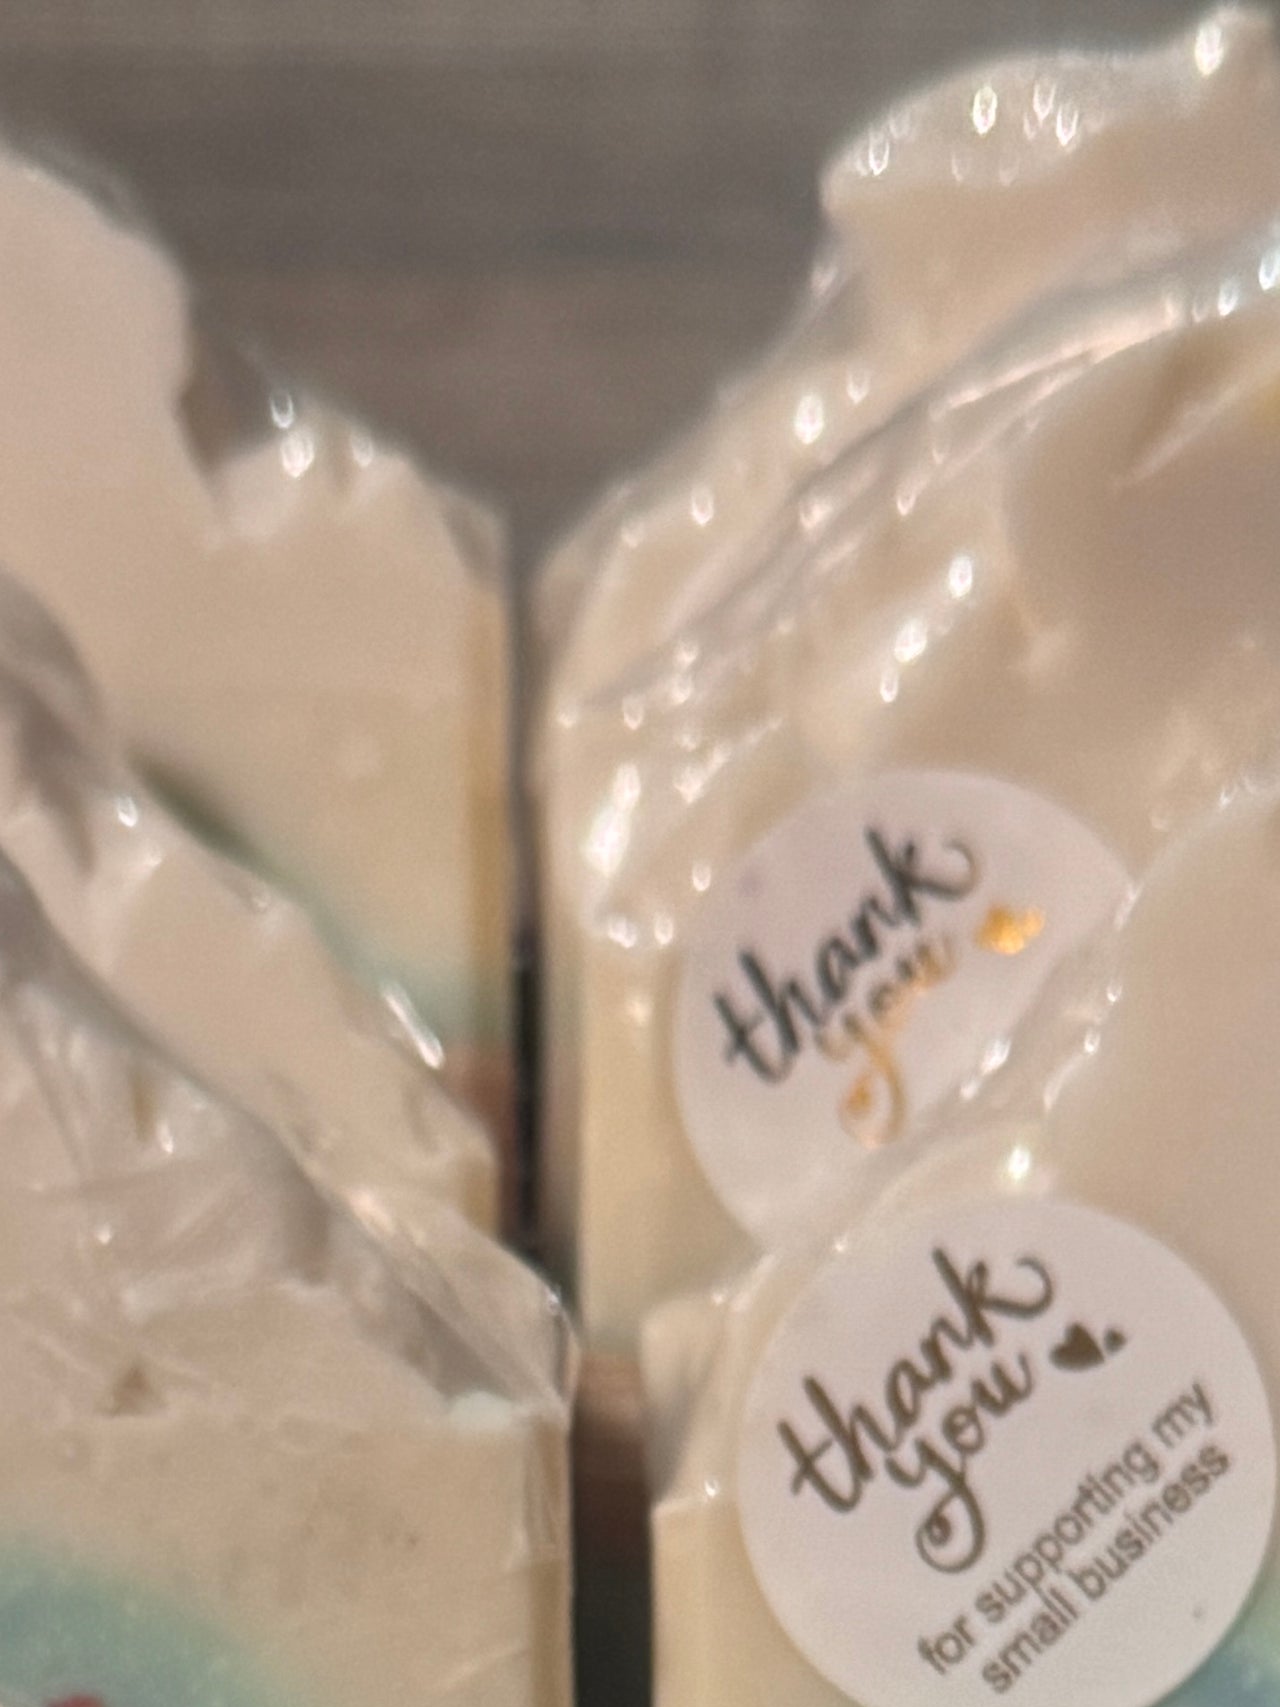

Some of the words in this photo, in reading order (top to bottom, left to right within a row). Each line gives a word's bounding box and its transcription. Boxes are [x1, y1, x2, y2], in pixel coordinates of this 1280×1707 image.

[714, 826, 980, 1085] thank
[816, 932, 958, 1148] you
[777, 1247, 1054, 1512] thank
[885, 1352, 1034, 1573] you
[917, 1615, 977, 1676] for
[975, 1434, 1160, 1625] supporting
[1152, 1381, 1217, 1451] my
[981, 1586, 1080, 1695] small
[1081, 1442, 1233, 1602] business
